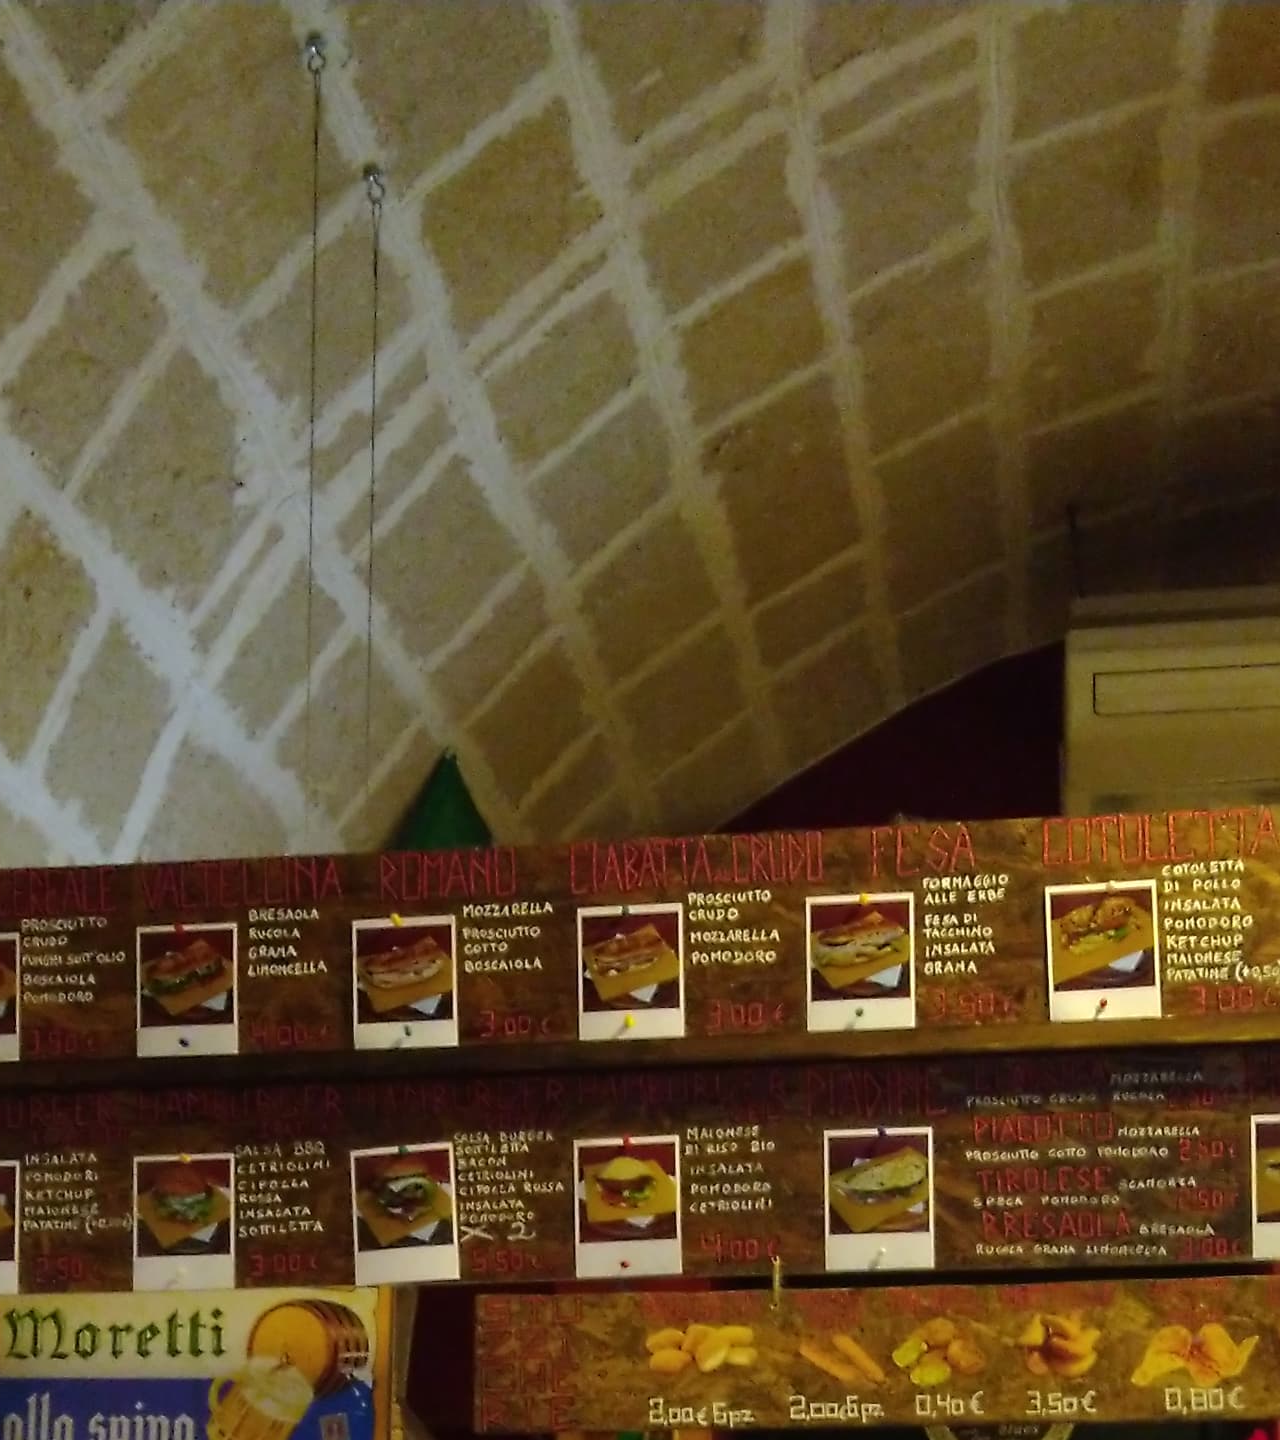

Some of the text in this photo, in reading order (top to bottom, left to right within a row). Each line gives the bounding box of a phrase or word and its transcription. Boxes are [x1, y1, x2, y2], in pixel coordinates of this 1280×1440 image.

[1043, 806, 1280, 868] COTOLETTA
[871, 821, 977, 878] FESA
[378, 848, 517, 900] ROMANO
[1162, 858, 1245, 877] COTOLETTA
[922, 873, 1009, 891] FORMAGGIO
[1164, 877, 1241, 892] DI POLLO
[688, 890, 771, 905] PROSCIUTTO
[923, 888, 1006, 905] ALLE ERBE
[463, 902, 554, 918] MOZZARELLA
[1164, 897, 1241, 912] INSALATA
[248, 908, 320, 922] BRESAOLA
[689, 908, 739, 921] CRUDO
[924, 913, 978, 927] FESA DI
[1165, 914, 1253, 931] POMODORO
[249, 928, 300, 941] RUCOLA
[464, 925, 540, 940] PROSCIUTTO
[690, 929, 780, 943] MOZZARELLA
[923, 925, 993, 939] TACCHINO
[23, 935, 68, 948] CRUDO
[465, 941, 508, 955] COTTO
[924, 941, 995, 957] INSALATA
[1165, 933, 1244, 950] KETCHUP
[248, 945, 297, 959] GRANA
[691, 949, 777, 965] POMODORO
[1166, 950, 1243, 966] MAIONESE
[247, 962, 327, 977] LIMONCELLA
[464, 957, 543, 973] BOSCAIOLA
[924, 960, 978, 975] GRANA
[22, 973, 95, 986] BOSCAIOLA
[1166, 965, 1229, 982] PATATINE
[1118, 1126, 1200, 1138] MOZZARELLA
[750, 1140, 776, 1153] BIO
[25, 1152, 98, 1166] INSALATA
[965, 1147, 1087, 1162] PROSCIUTTO COTTO
[458, 1156, 508, 1169] BACON
[508, 1222, 537, 1241] 2
[5, 1307, 226, 1361] Moretti
[916, 1394, 964, 1419] 0,40
